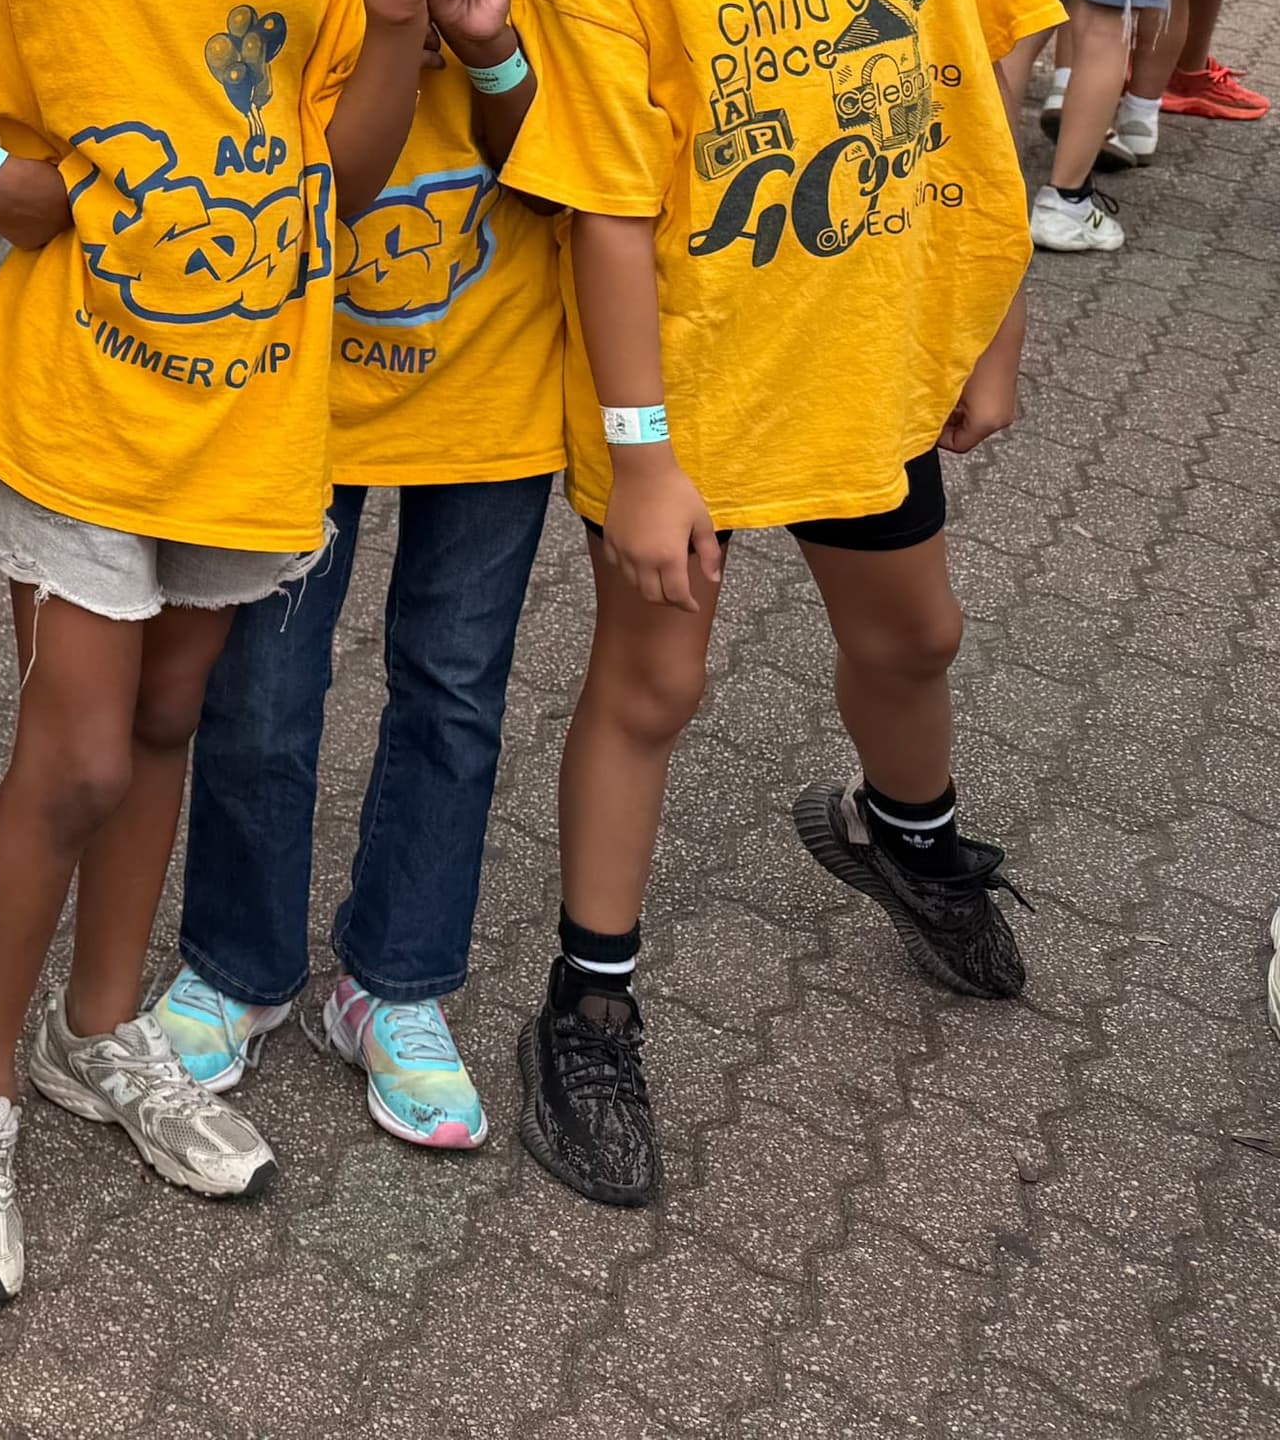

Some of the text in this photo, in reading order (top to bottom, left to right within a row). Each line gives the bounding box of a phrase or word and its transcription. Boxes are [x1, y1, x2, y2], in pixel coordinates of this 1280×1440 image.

[711, 39, 838, 99] Place
[214, 135, 287, 176] ACP
[225, 342, 292, 389] CP
[341, 337, 436, 374] CAMP
